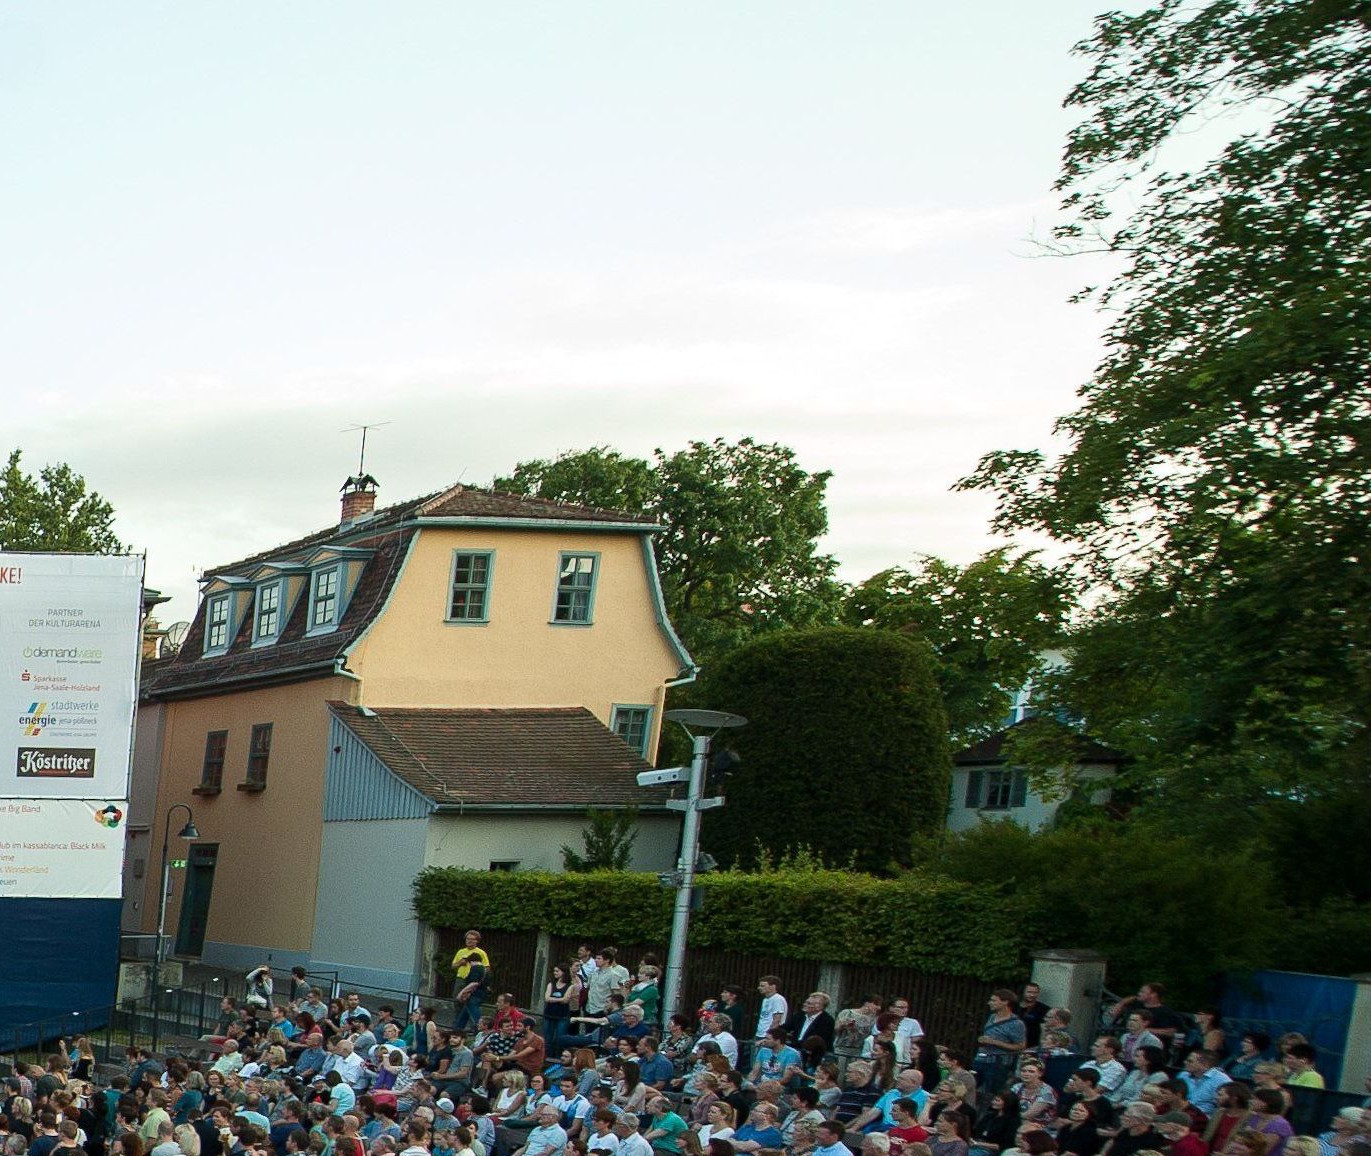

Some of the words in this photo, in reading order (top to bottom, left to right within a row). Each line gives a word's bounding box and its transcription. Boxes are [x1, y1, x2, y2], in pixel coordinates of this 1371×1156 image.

[47, 608, 84, 617] PARTNER
[28, 619, 45, 627] DER
[45, 620, 101, 629] KULTURARENA
[33, 646, 102, 658] demandware
[33, 675, 67, 683] Sparkasse
[50, 700, 100, 712] stadtwerke
[18, 714, 57, 728] energie
[20, 750, 92, 773] Köstritzer
[8, 804, 20, 814] Big
[21, 804, 41, 813] Band
[70, 842, 90, 850] Black
